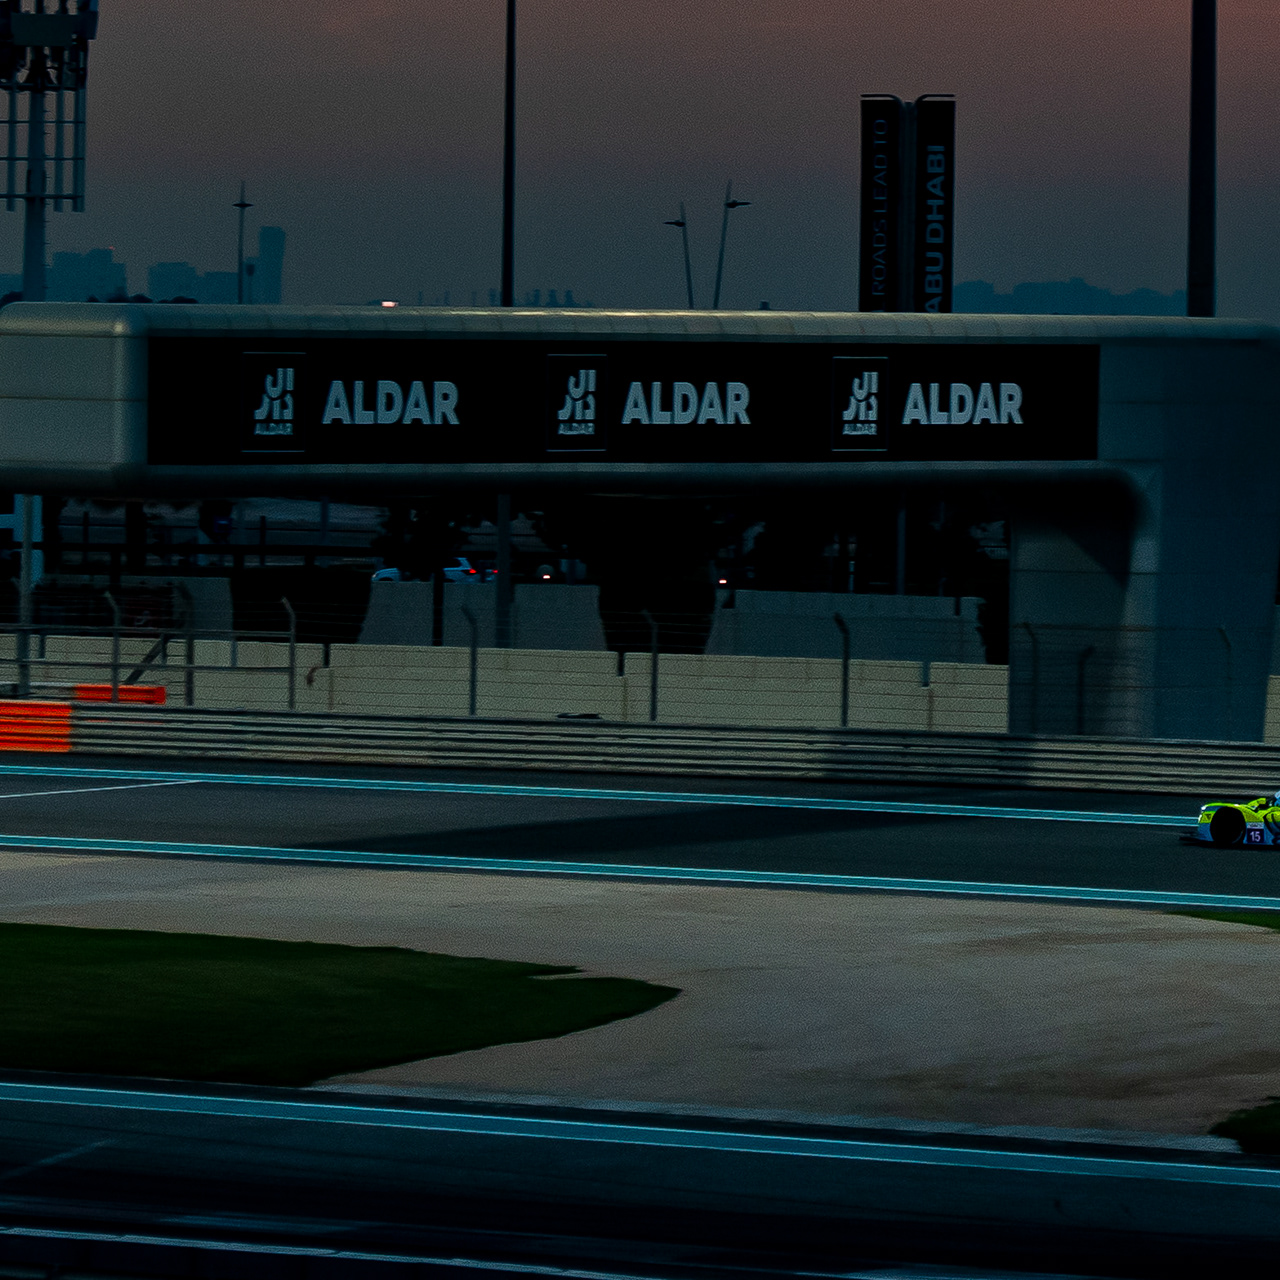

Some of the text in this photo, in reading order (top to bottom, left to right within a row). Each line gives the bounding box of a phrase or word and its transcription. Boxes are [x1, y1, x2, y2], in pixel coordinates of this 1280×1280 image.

[874, 118, 889, 151] TO
[873, 154, 889, 214] LEAD
[923, 144, 947, 312] ABU DHABI
[872, 219, 888, 297] ROADS
[321, 380, 461, 425] ALDAR
[620, 381, 752, 425] ALDAR
[901, 382, 1025, 425] ALDAR
[1250, 830, 1261, 842] 15
